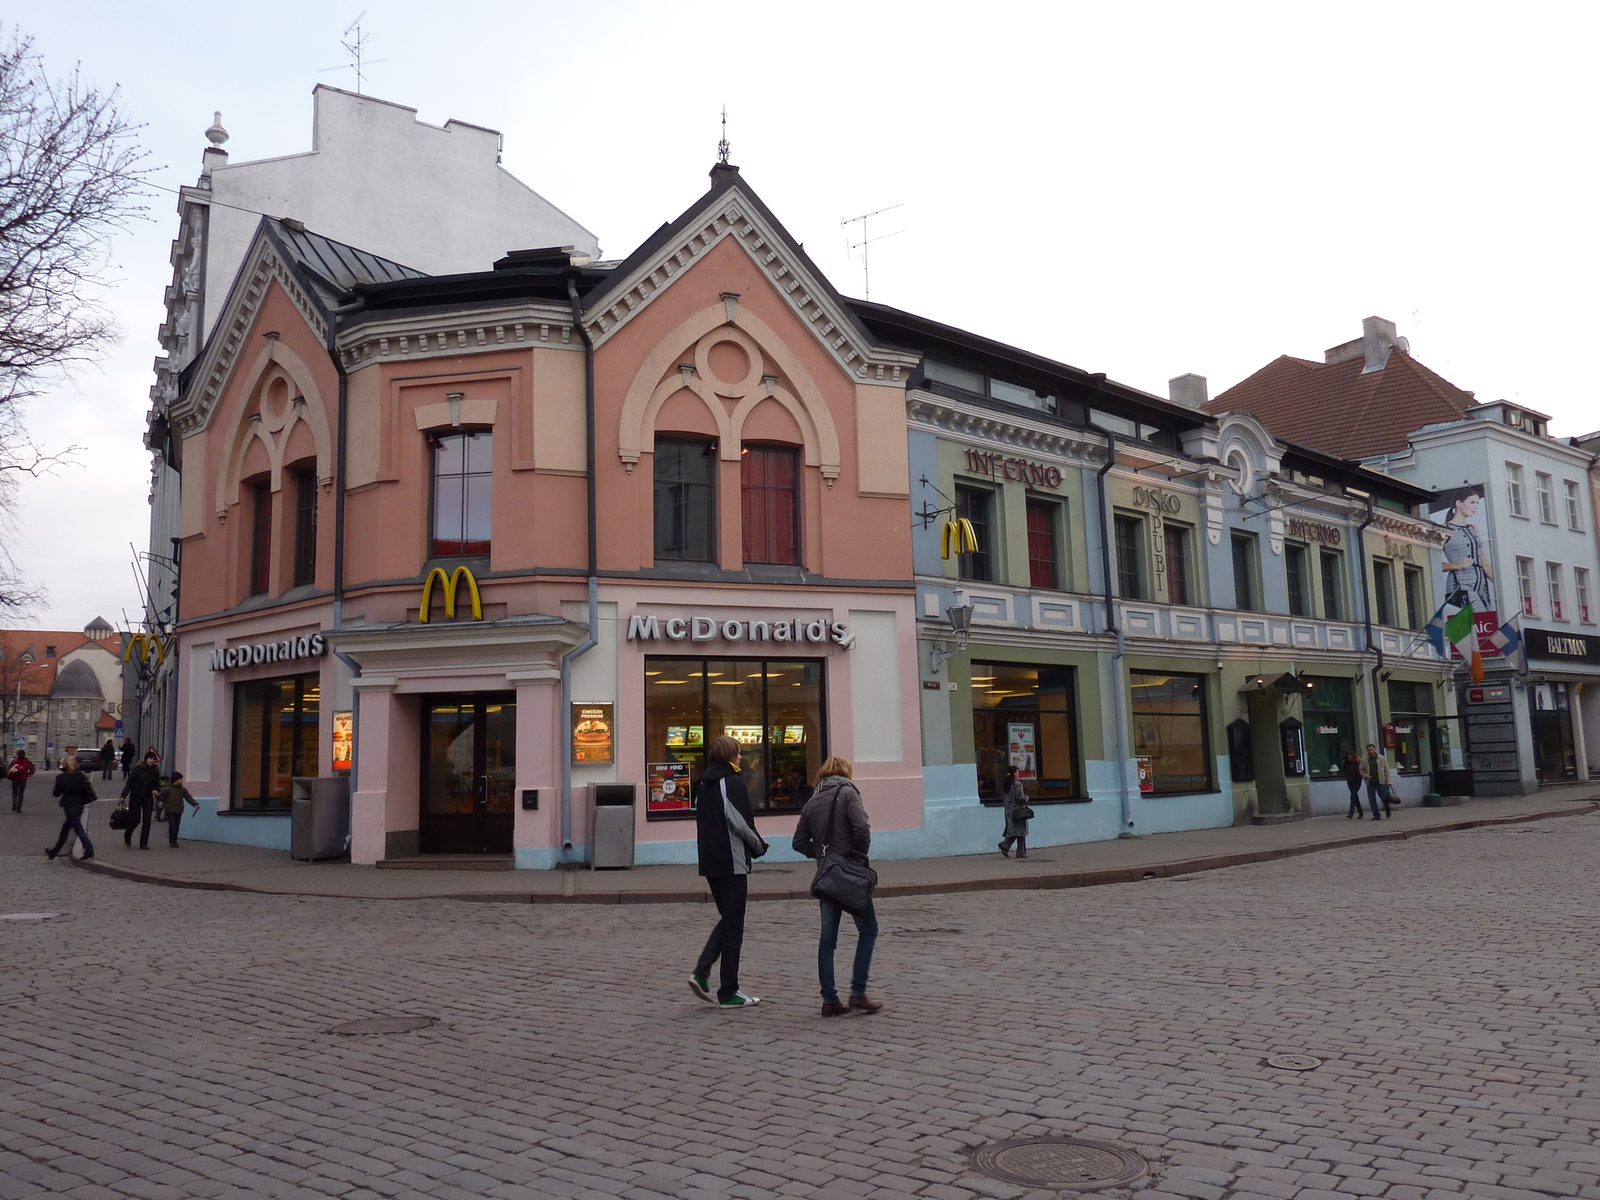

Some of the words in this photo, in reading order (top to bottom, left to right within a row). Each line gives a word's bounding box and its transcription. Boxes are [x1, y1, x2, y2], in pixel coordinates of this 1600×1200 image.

[962, 448, 1061, 492] INFERNO
[1133, 485, 1181, 518] DISKO
[1289, 517, 1341, 548] INFERNO
[1150, 514, 1166, 592] PUBI
[1383, 534, 1416, 566] BAAR
[627, 614, 849, 643] McDonald's
[208, 633, 325, 672] McDonald's
[1546, 636, 1587, 656] BALTMAN
